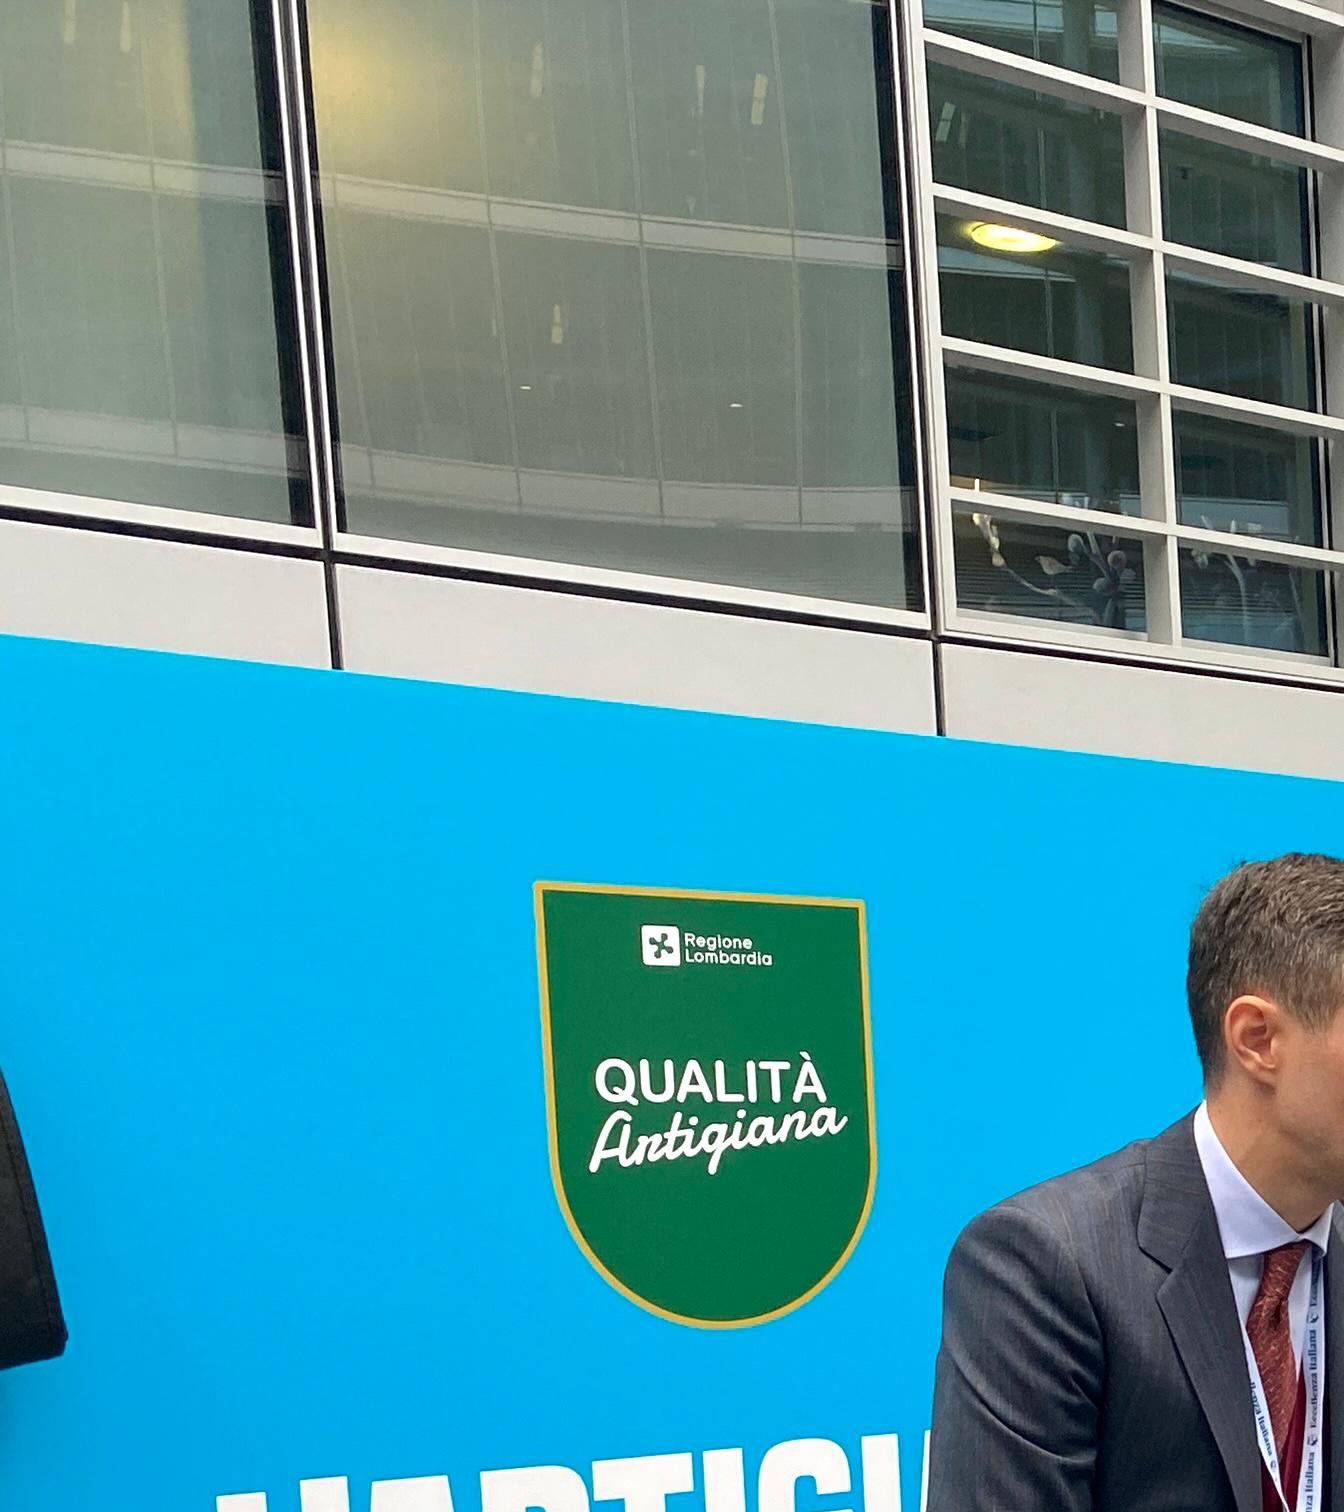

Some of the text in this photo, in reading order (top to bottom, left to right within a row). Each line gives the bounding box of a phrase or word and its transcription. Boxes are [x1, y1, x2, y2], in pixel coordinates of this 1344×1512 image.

[685, 933, 752, 950] Regione
[685, 950, 772, 967] Lombardia
[595, 1051, 826, 1106] QUALITÀ
[589, 1106, 848, 1174] Artigiana
[1304, 1451, 1315, 1496] Italiana
